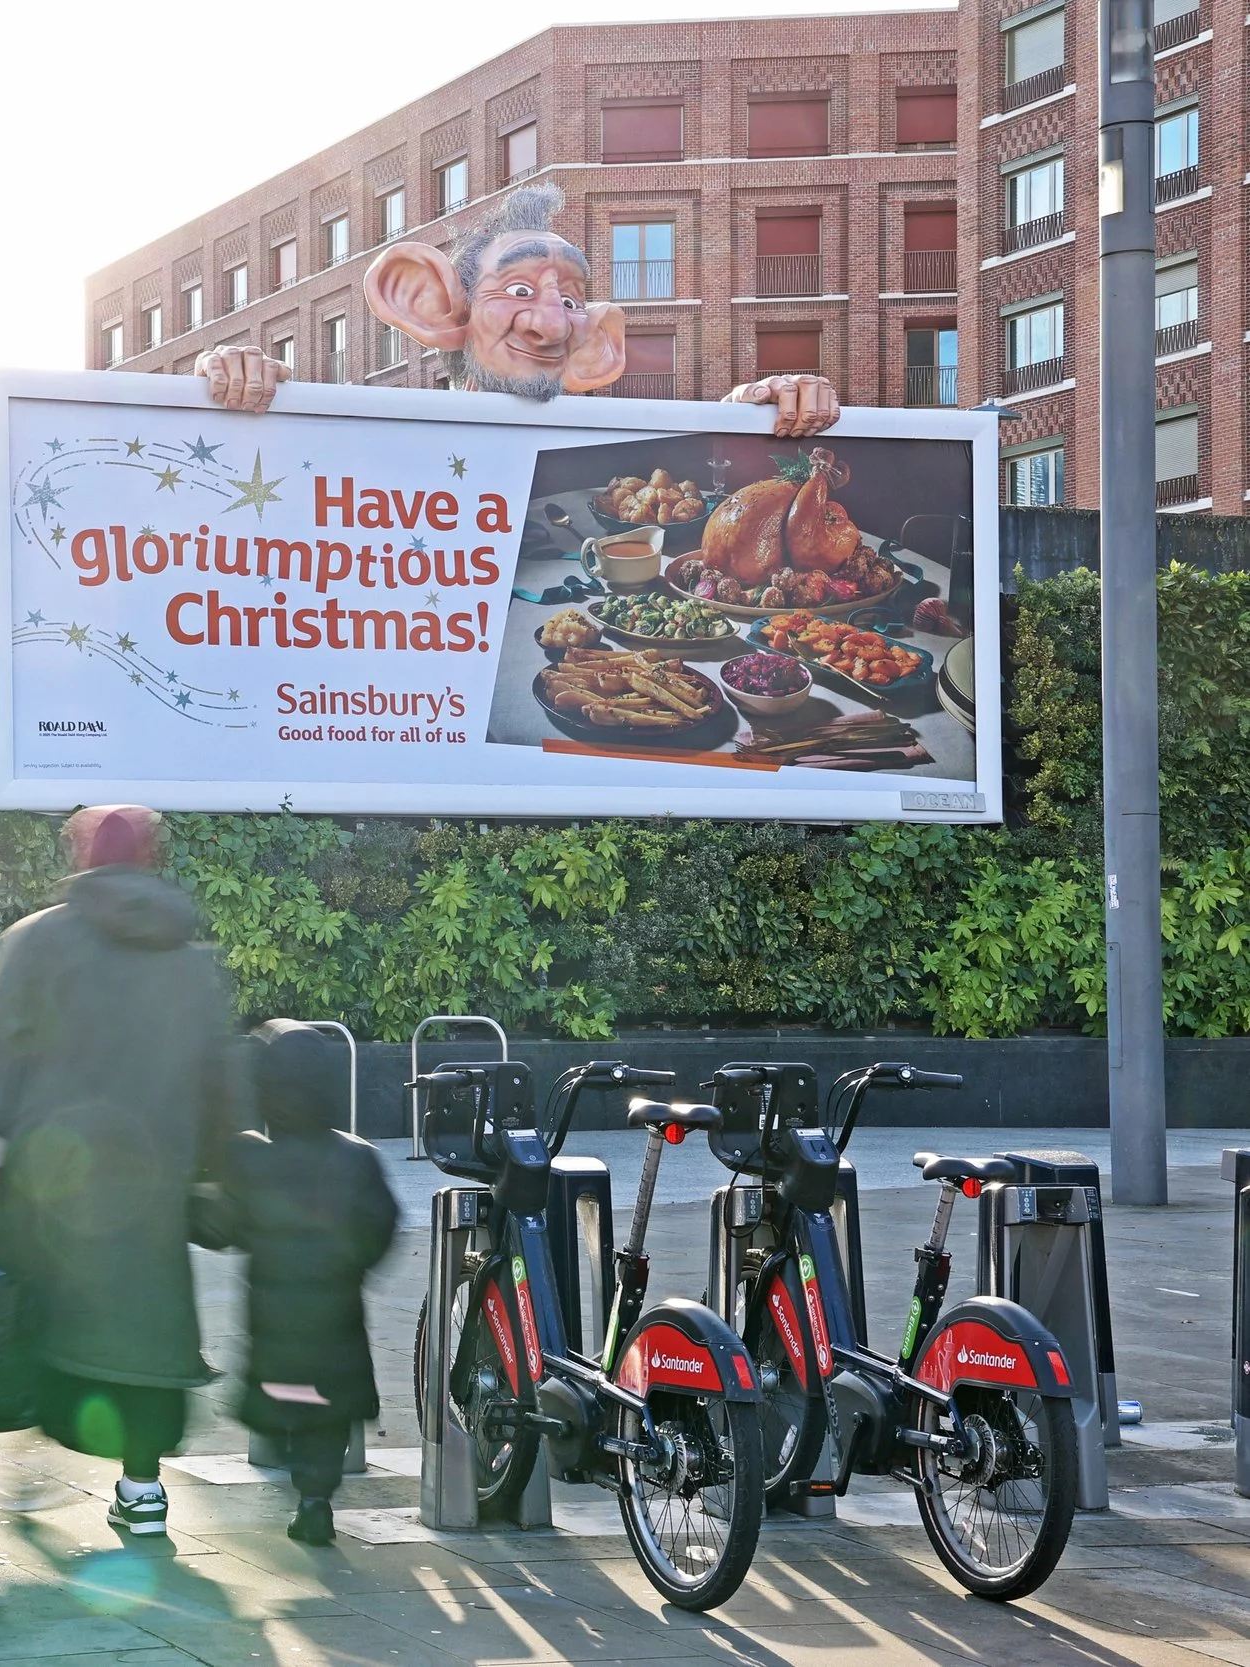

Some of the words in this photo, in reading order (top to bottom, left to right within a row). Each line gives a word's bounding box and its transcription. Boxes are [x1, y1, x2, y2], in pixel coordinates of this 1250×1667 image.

[314, 476, 459, 532] Have
[476, 493, 512, 533] a
[70, 524, 500, 593] gloriumptious
[165, 590, 491, 653] Christmas!
[276, 682, 466, 724] Sainsbury's
[38, 721, 76, 732] ROALD
[78, 720, 107, 733] DAHL
[278, 725, 323, 741] Good
[327, 725, 366, 742] food
[370, 726, 396, 742] for
[400, 727, 421, 742] all
[425, 727, 442, 743] of
[447, 731, 466, 743] us
[913, 792, 976, 810] OCEAN
[491, 1310, 514, 1364] Santander
[776, 1305, 801, 1358] Santander
[901, 1316, 915, 1355] Electric
[661, 1354, 705, 1374] Santander
[968, 1349, 1017, 1370] Santander
